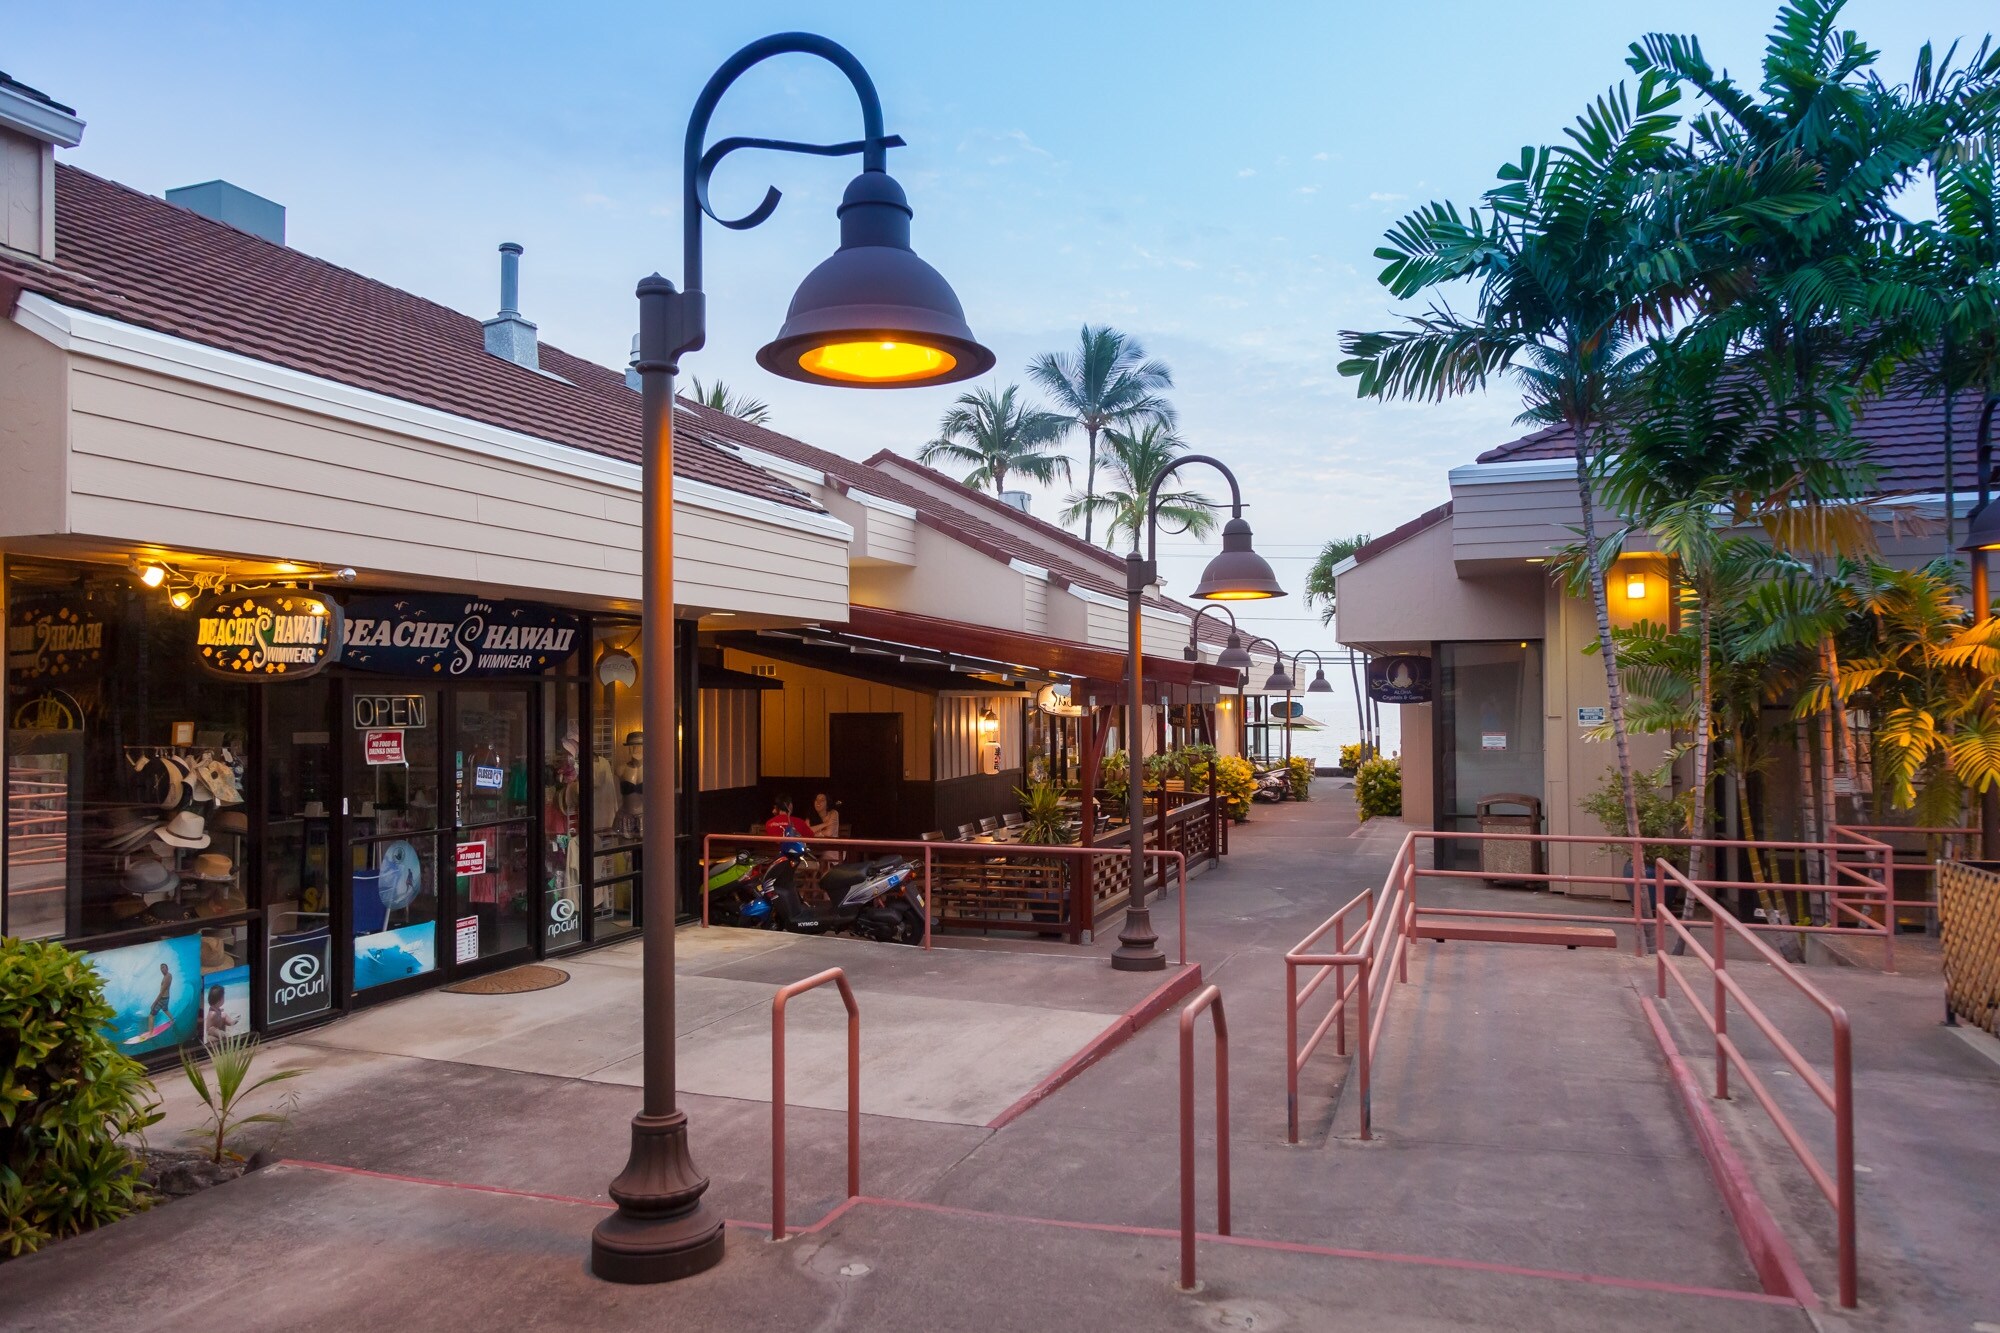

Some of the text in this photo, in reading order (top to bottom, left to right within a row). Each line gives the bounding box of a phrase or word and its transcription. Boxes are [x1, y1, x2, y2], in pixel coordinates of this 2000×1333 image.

[482, 625, 575, 651] HAWAII
[357, 697, 424, 726] OPEN
[478, 769, 493, 779] CLOSED
